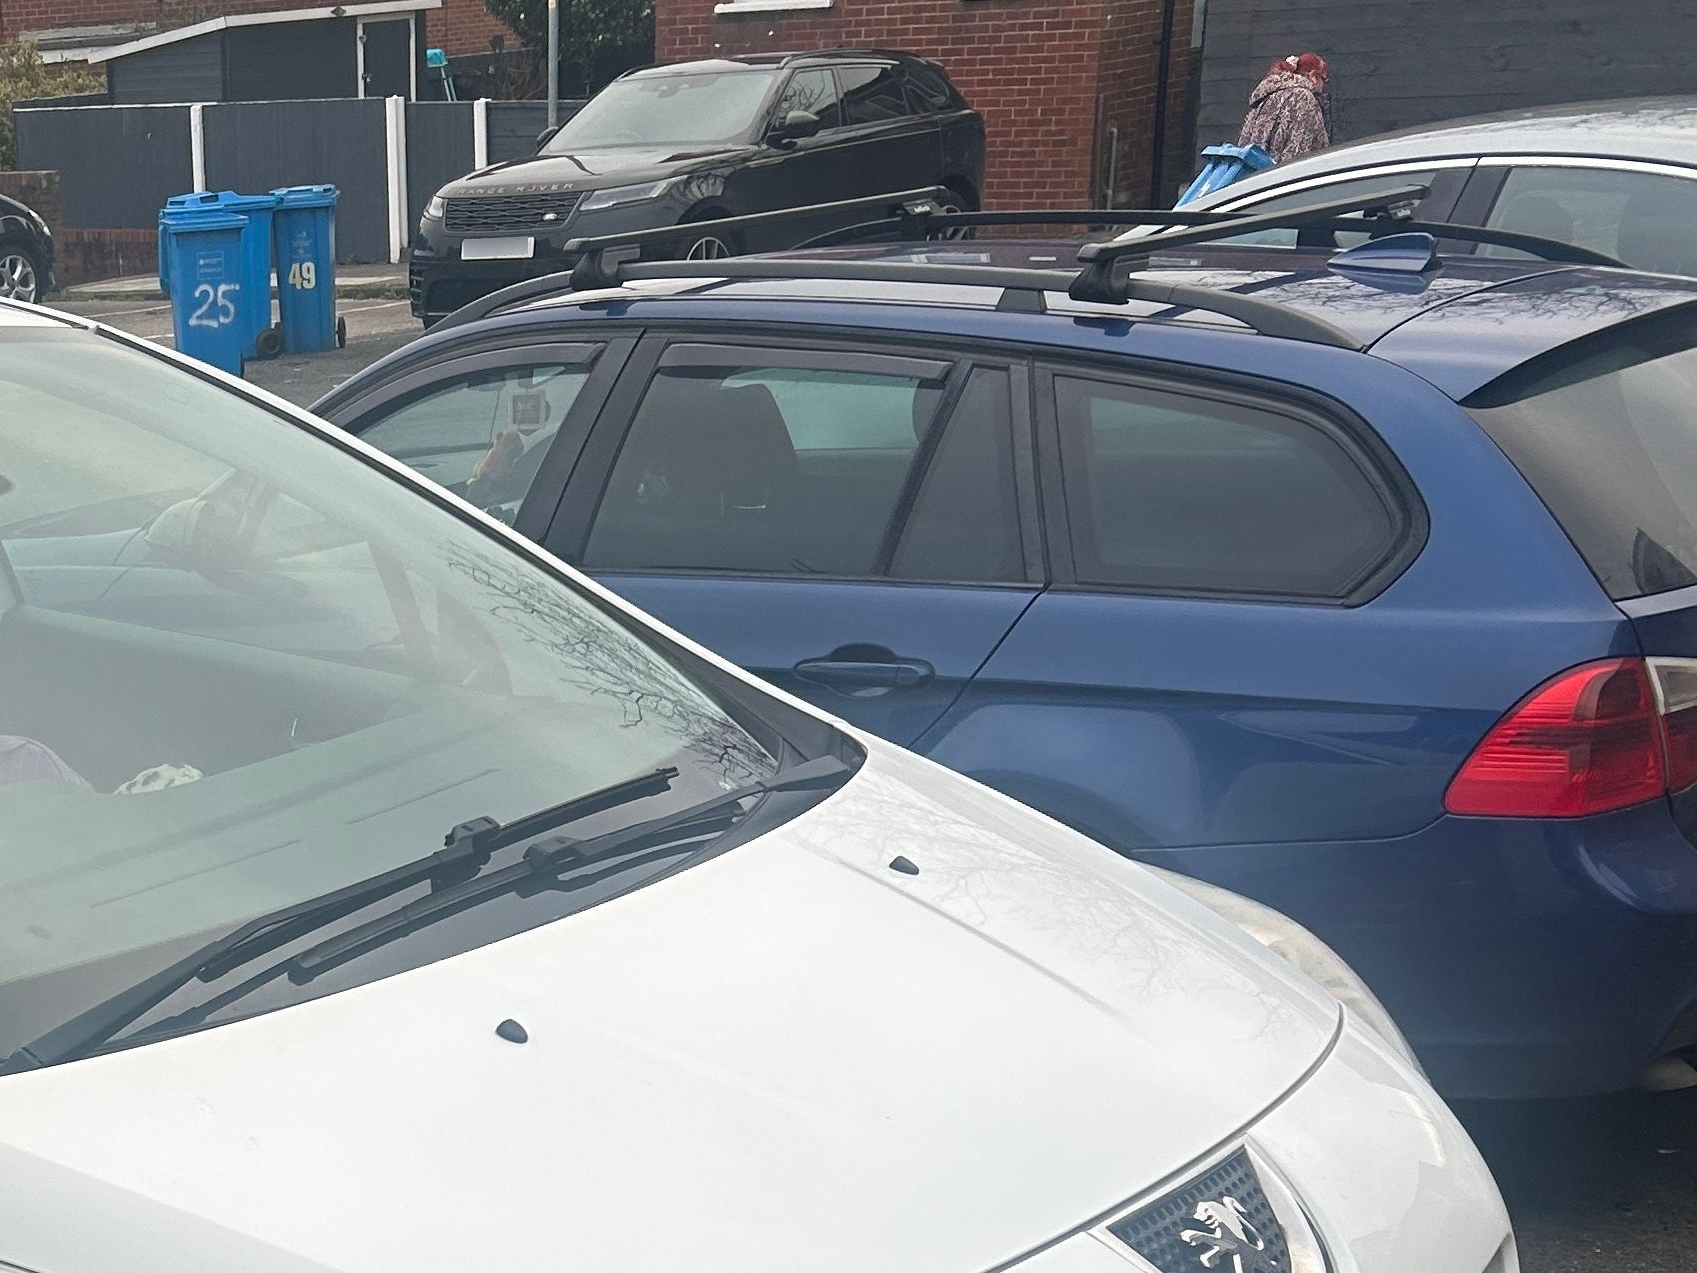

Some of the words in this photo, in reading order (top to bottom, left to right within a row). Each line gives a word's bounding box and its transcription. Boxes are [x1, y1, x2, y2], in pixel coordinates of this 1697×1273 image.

[458, 187, 505, 195] RANGE
[515, 183, 574, 193] ROVER
[288, 261, 316, 290] 49
[188, 283, 241, 329] 25
